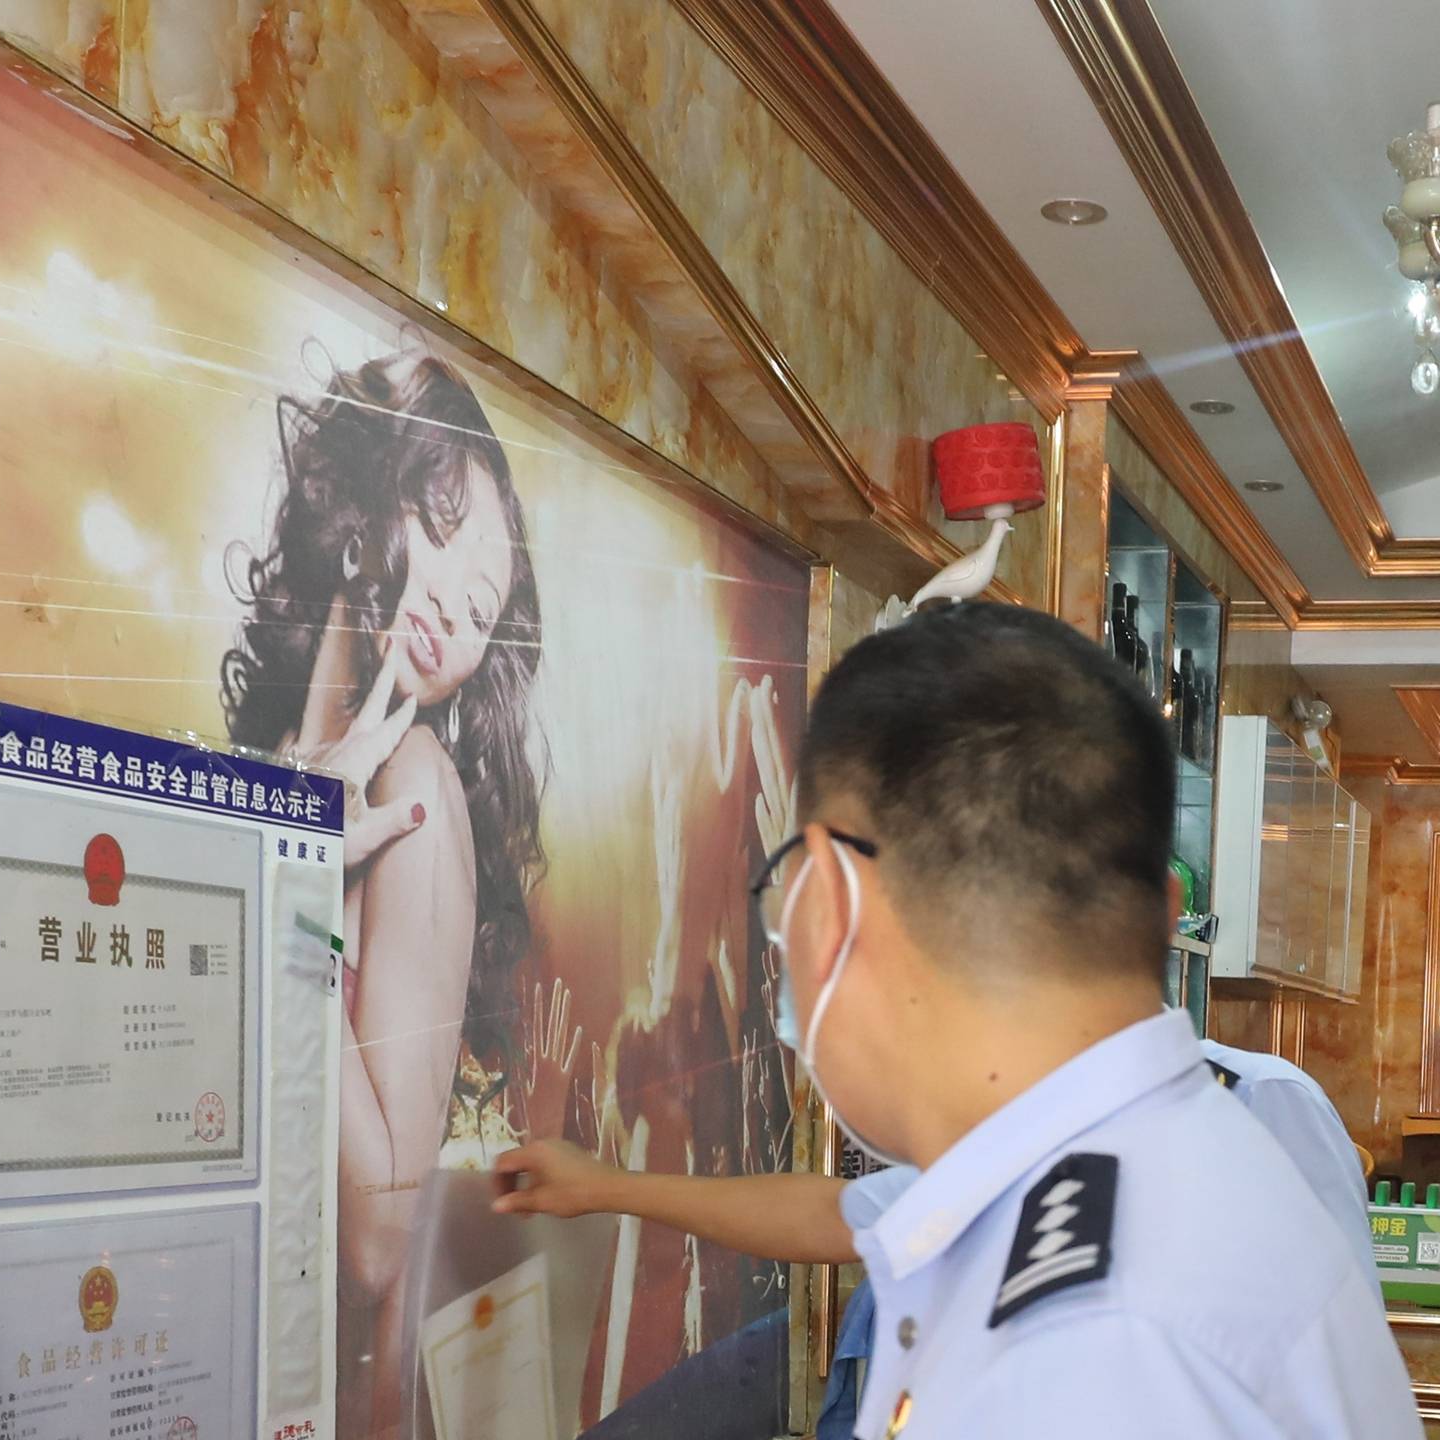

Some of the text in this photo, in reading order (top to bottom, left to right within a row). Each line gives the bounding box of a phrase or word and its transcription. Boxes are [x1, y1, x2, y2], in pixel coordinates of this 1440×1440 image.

[277, 837, 327, 863] 健康证
[38, 915, 166, 970] 营业执照
[17, 1328, 169, 1379] 食品经营许可证
